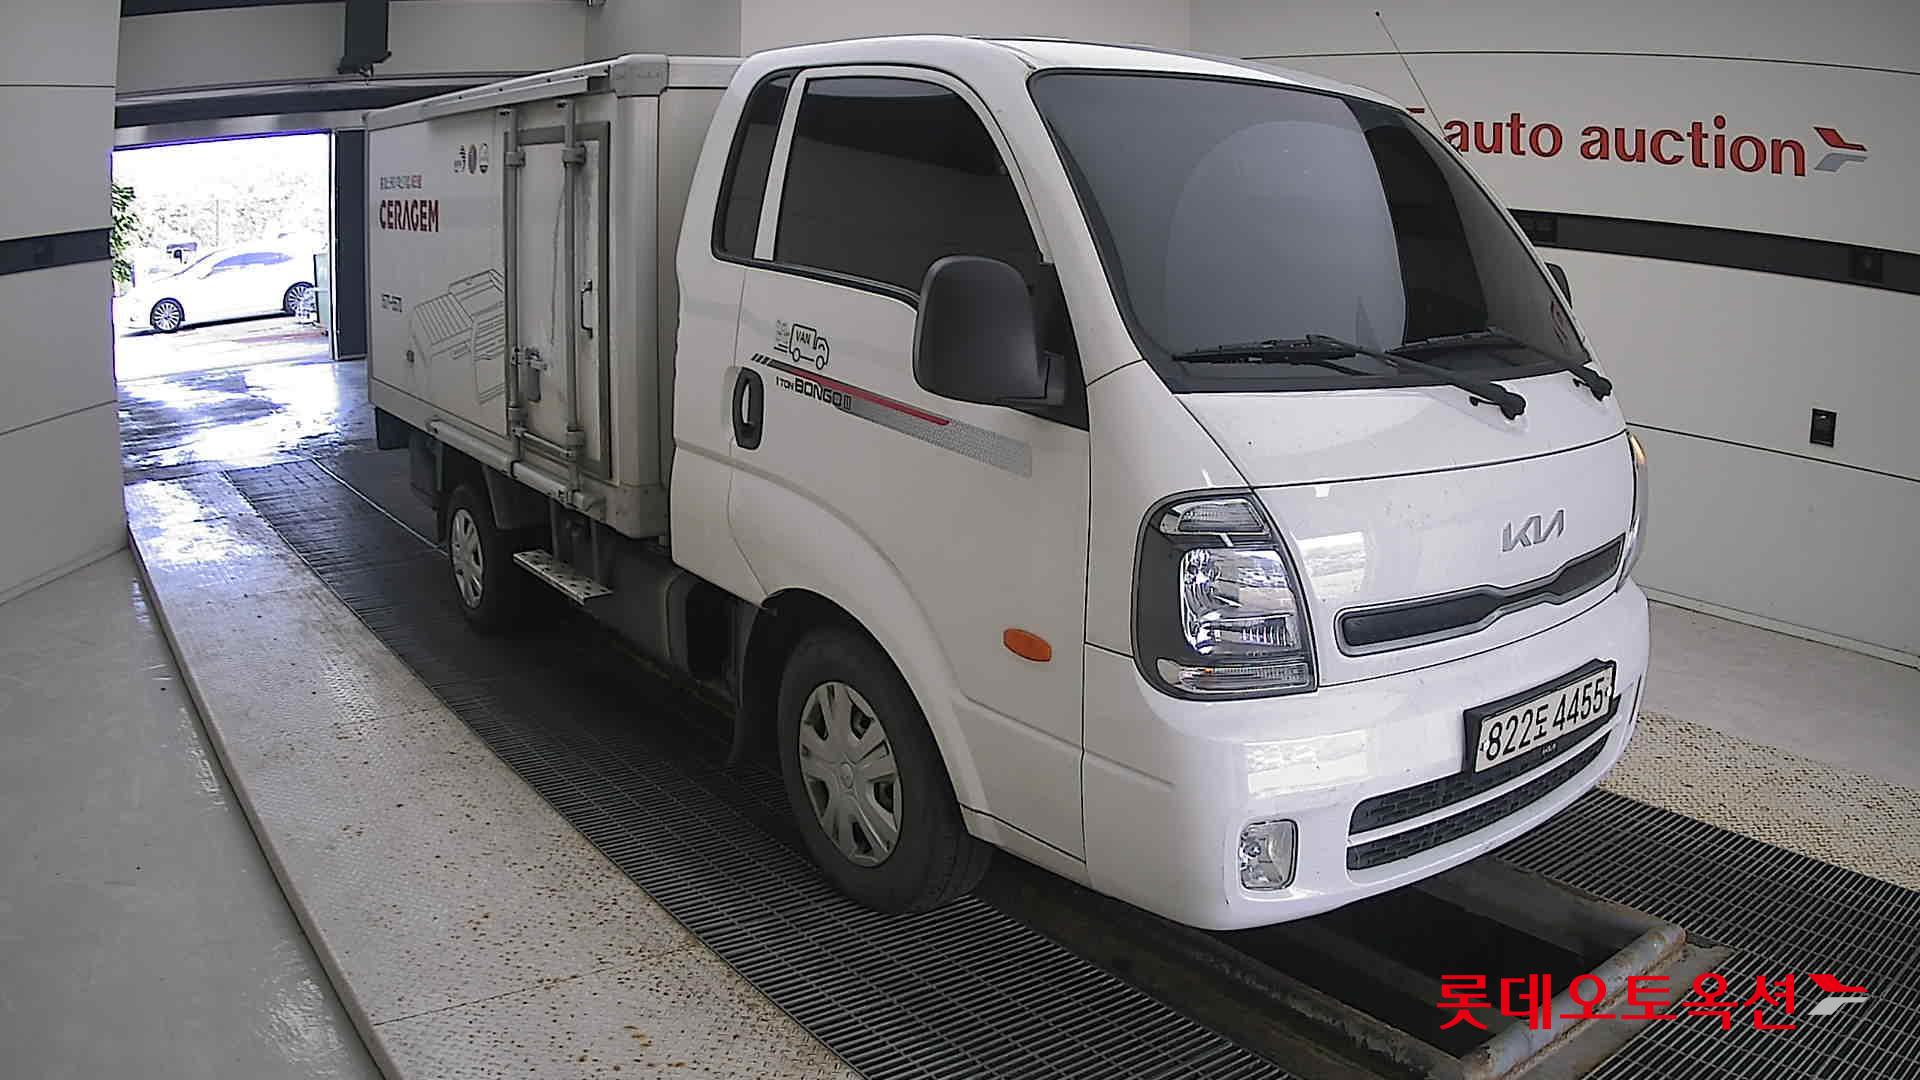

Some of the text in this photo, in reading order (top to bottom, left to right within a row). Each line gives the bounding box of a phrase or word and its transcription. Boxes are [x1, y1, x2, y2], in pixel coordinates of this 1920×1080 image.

[1443, 112, 1807, 177] auto auction
[379, 199, 439, 233] CERAGEM
[796, 330, 811, 345] VAN
[795, 378, 842, 407] BONGO
[1502, 509, 1564, 552] KIA
[1486, 676, 1605, 761] 822도 4455
